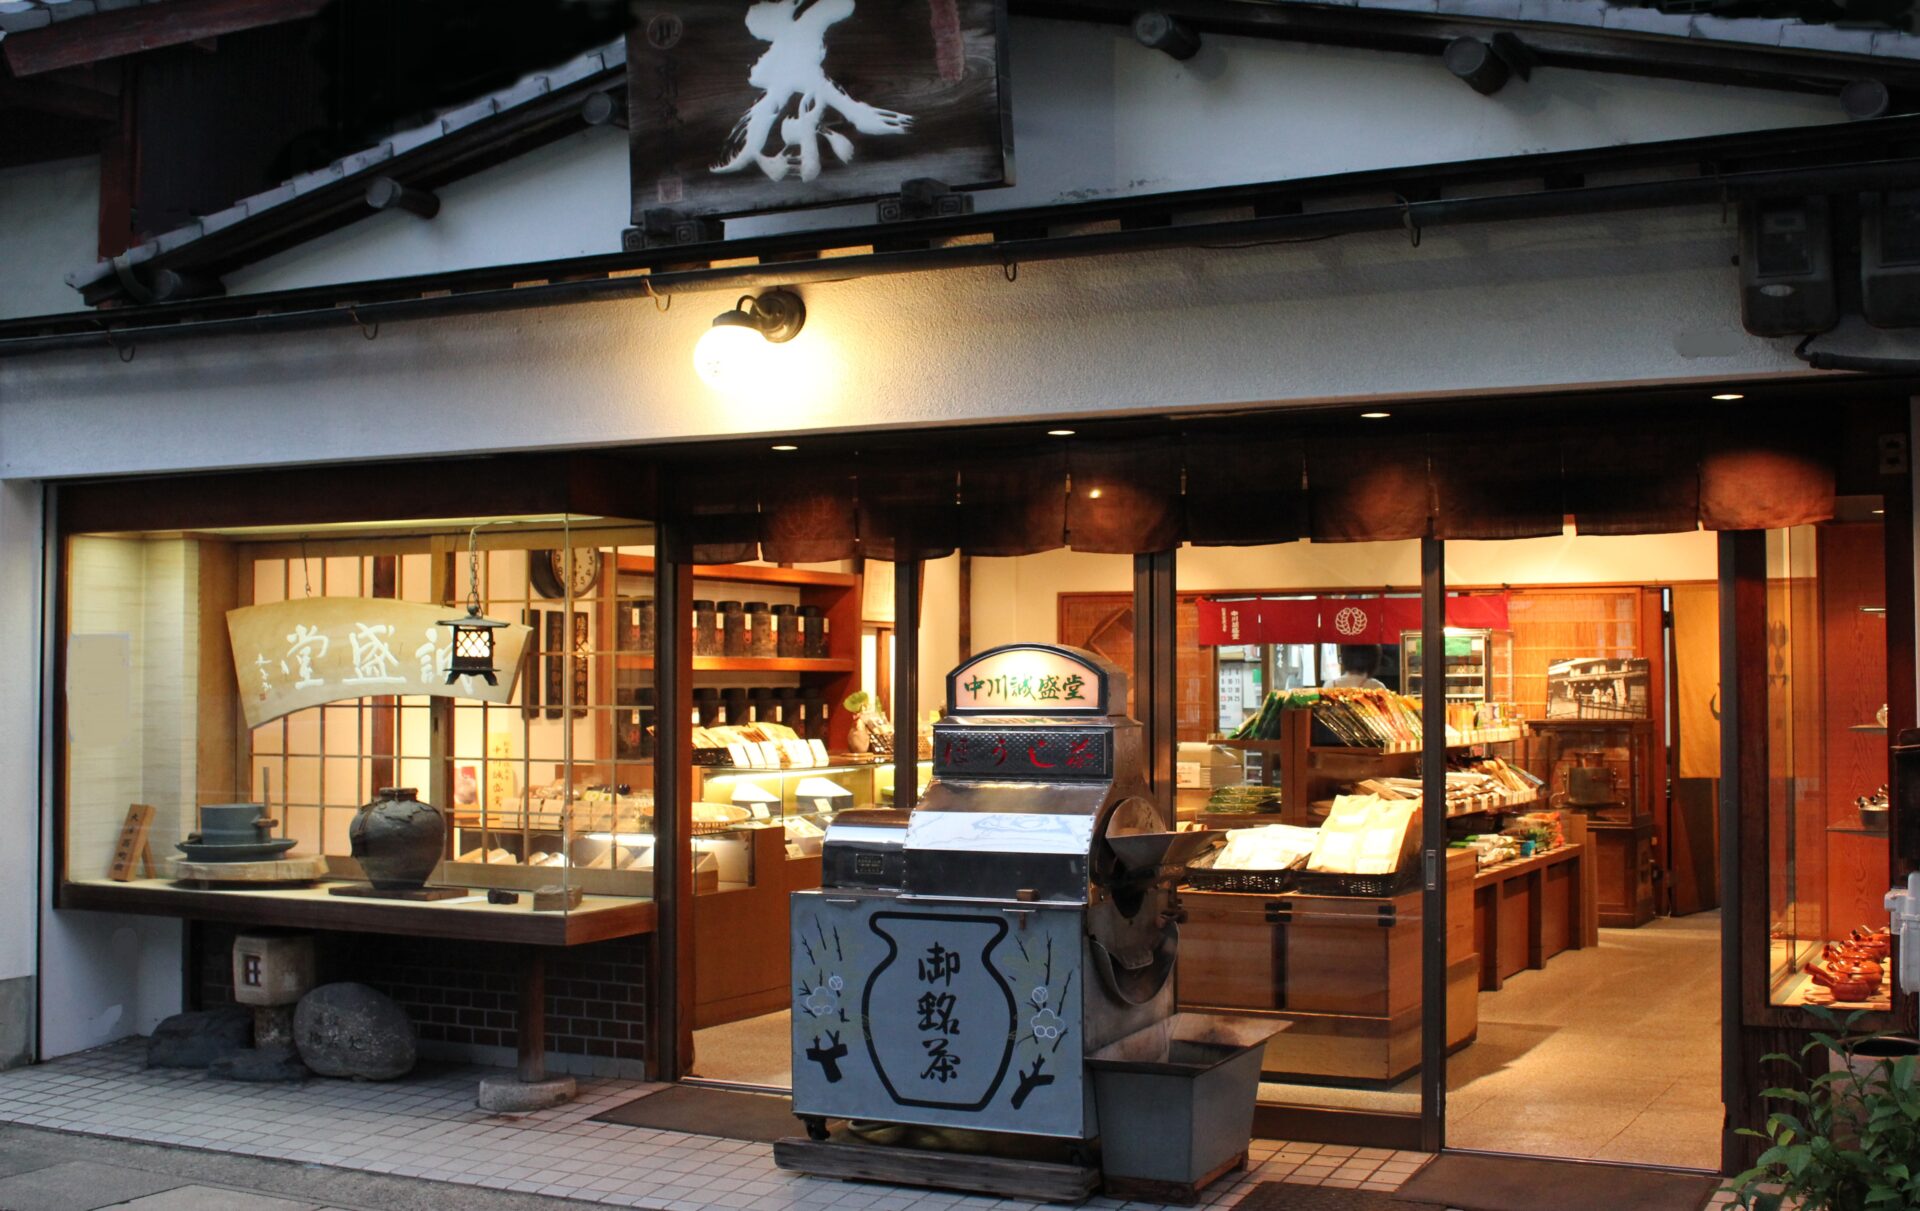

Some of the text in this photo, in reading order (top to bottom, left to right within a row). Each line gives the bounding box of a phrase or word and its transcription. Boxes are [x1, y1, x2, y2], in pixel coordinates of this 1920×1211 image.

[964, 674, 1086, 701] 中川誠盛堂
[943, 735, 1095, 770] ほうじ茶
[917, 941, 962, 1083] 御銘茶
